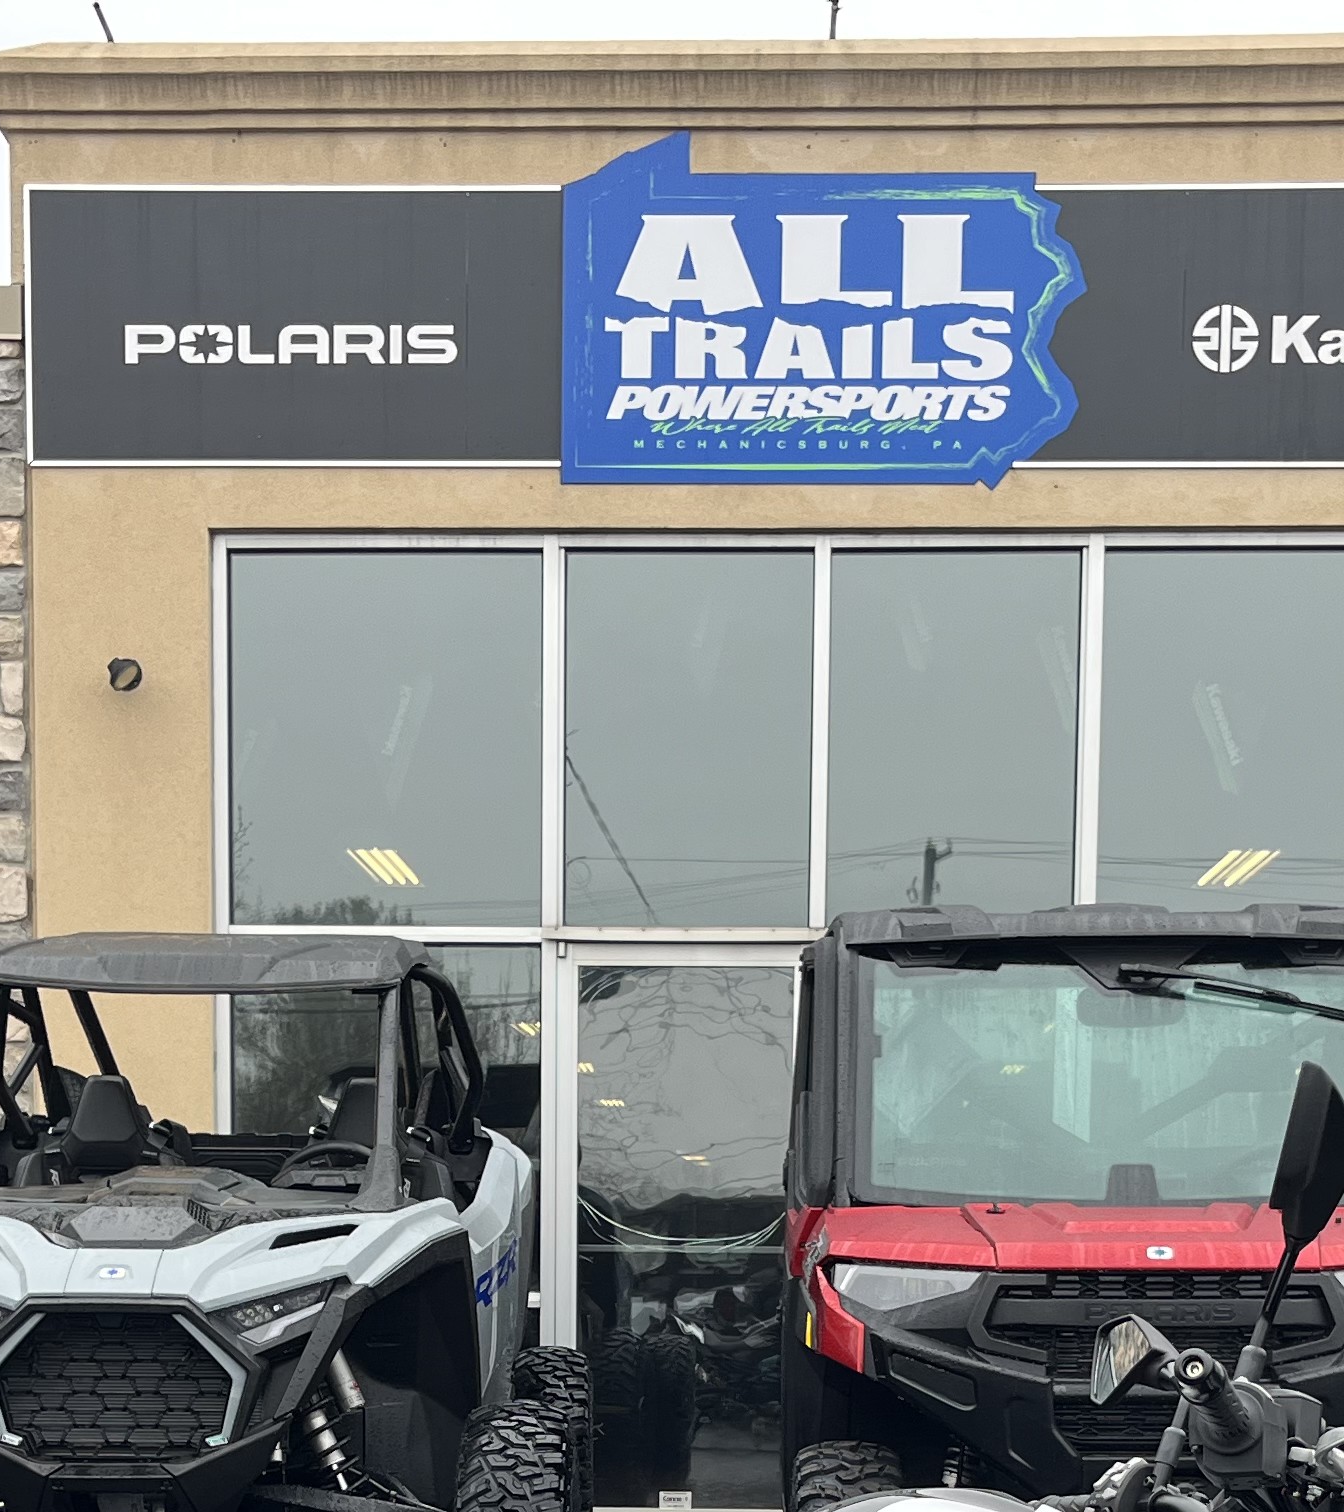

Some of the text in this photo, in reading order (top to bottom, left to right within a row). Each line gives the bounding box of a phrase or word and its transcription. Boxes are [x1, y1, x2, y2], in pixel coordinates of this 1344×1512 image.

[615, 214, 1014, 316] ALL
[124, 324, 458, 364] POLARIS
[604, 316, 1014, 381] TRAILS
[605, 385, 1012, 422] POWERSPORTS
[932, 440, 962, 450] PA
